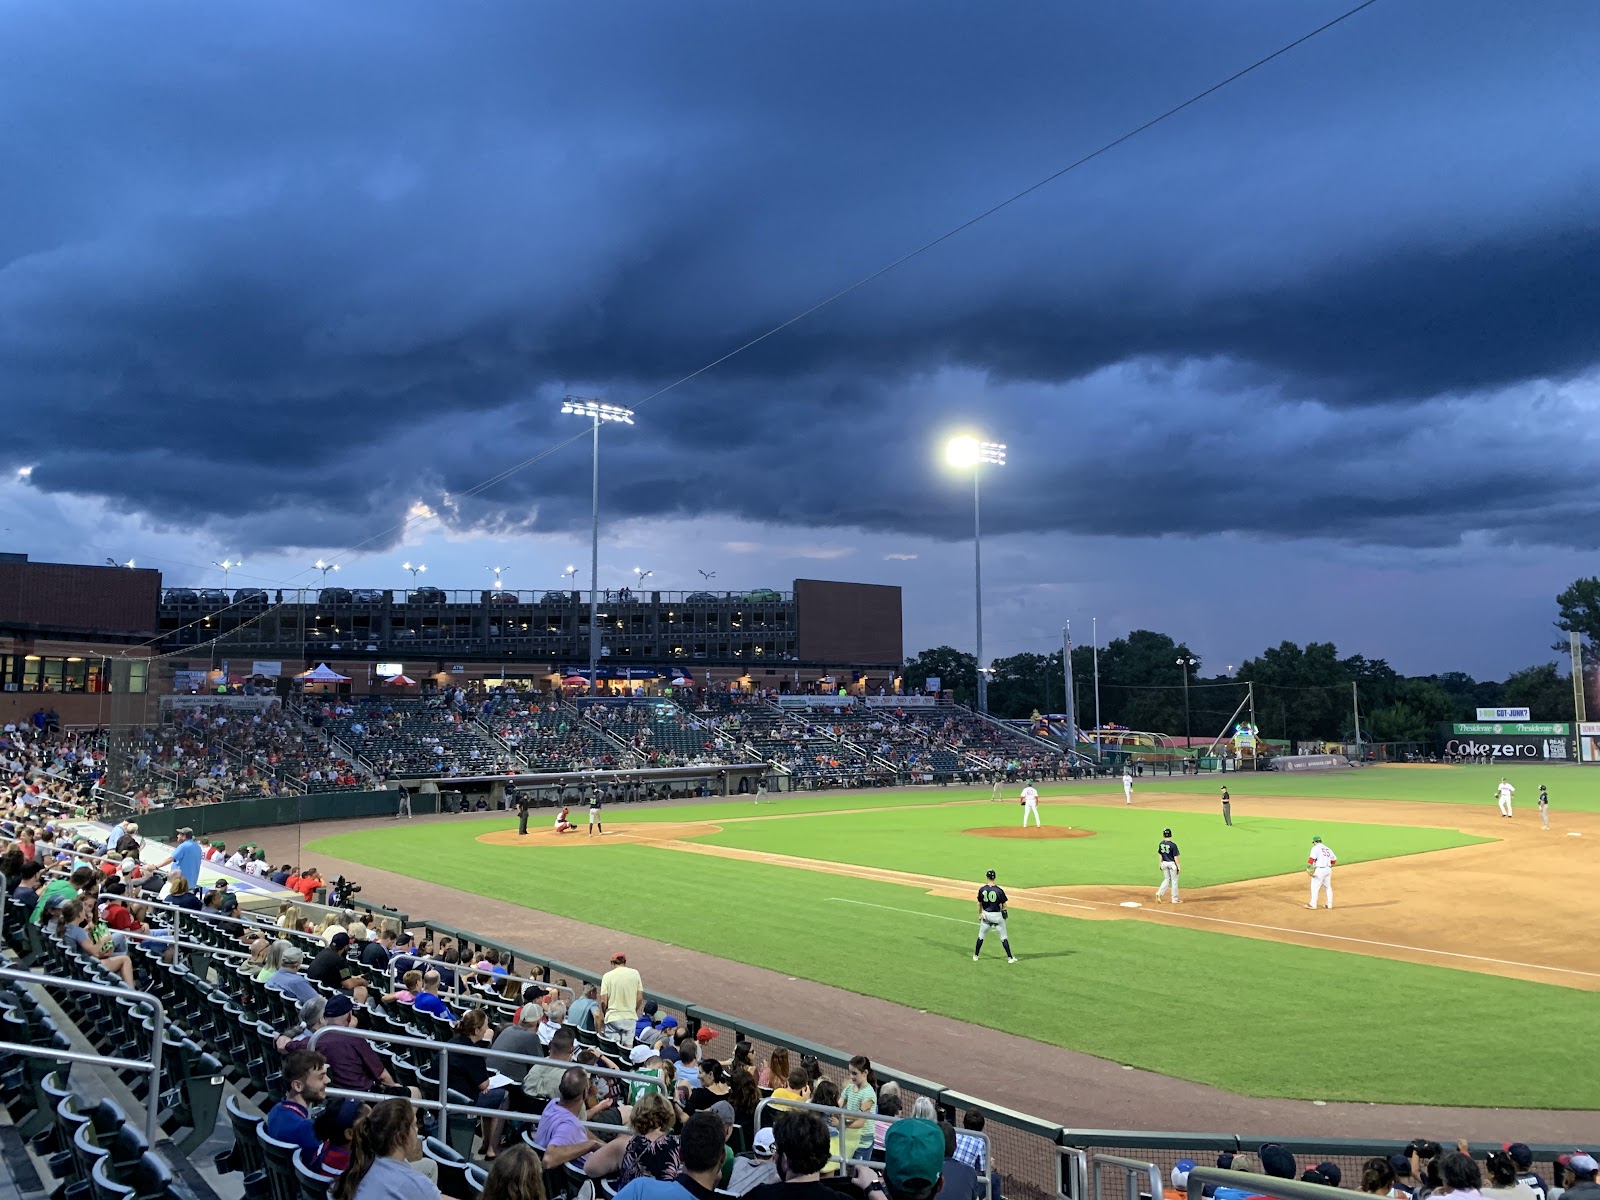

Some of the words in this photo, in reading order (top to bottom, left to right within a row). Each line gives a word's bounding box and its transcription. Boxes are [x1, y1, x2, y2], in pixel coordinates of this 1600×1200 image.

[1496, 709, 1528, 717] GOT-JUNK?
[1458, 723, 1492, 732] Presidente
[1516, 723, 1552, 732] Presidente
[1321, 847, 1331, 858] 55
[982, 889, 997, 903] 10
